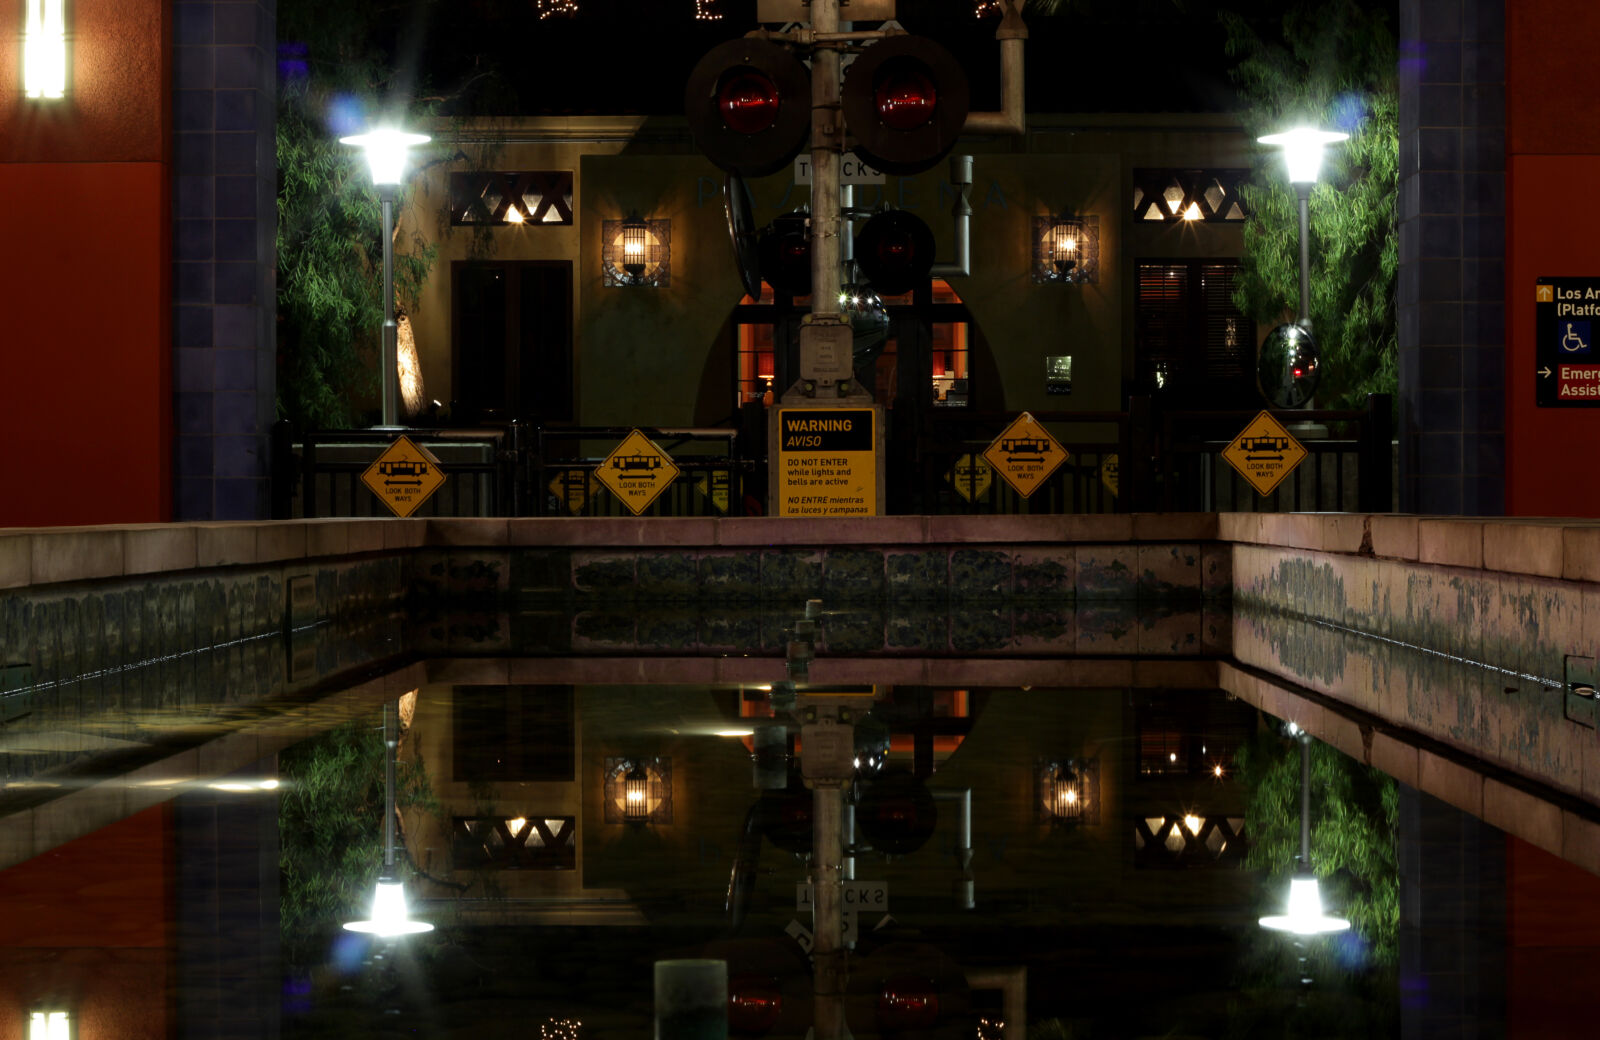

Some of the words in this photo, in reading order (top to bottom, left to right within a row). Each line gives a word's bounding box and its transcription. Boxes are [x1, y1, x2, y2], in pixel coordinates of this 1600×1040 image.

[799, 162, 882, 177] TCKS
[1557, 287, 1581, 300] Los
[787, 419, 853, 432] WARNING
[787, 435, 822, 447] AVISO
[787, 458, 799, 466] DO
[801, 458, 818, 466] NOT
[820, 458, 848, 466] ENTER
[787, 468, 810, 476] while
[811, 468, 834, 478] lights
[836, 468, 851, 476] and
[787, 478, 808, 486] bells
[825, 478, 848, 486] active
[787, 496, 800, 504] NO
[801, 496, 828, 504] ENTRE
[829, 496, 864, 504] mientras
[787, 506, 799, 514] las
[800, 506, 822, 514] luces
[829, 507, 868, 515] campanas
